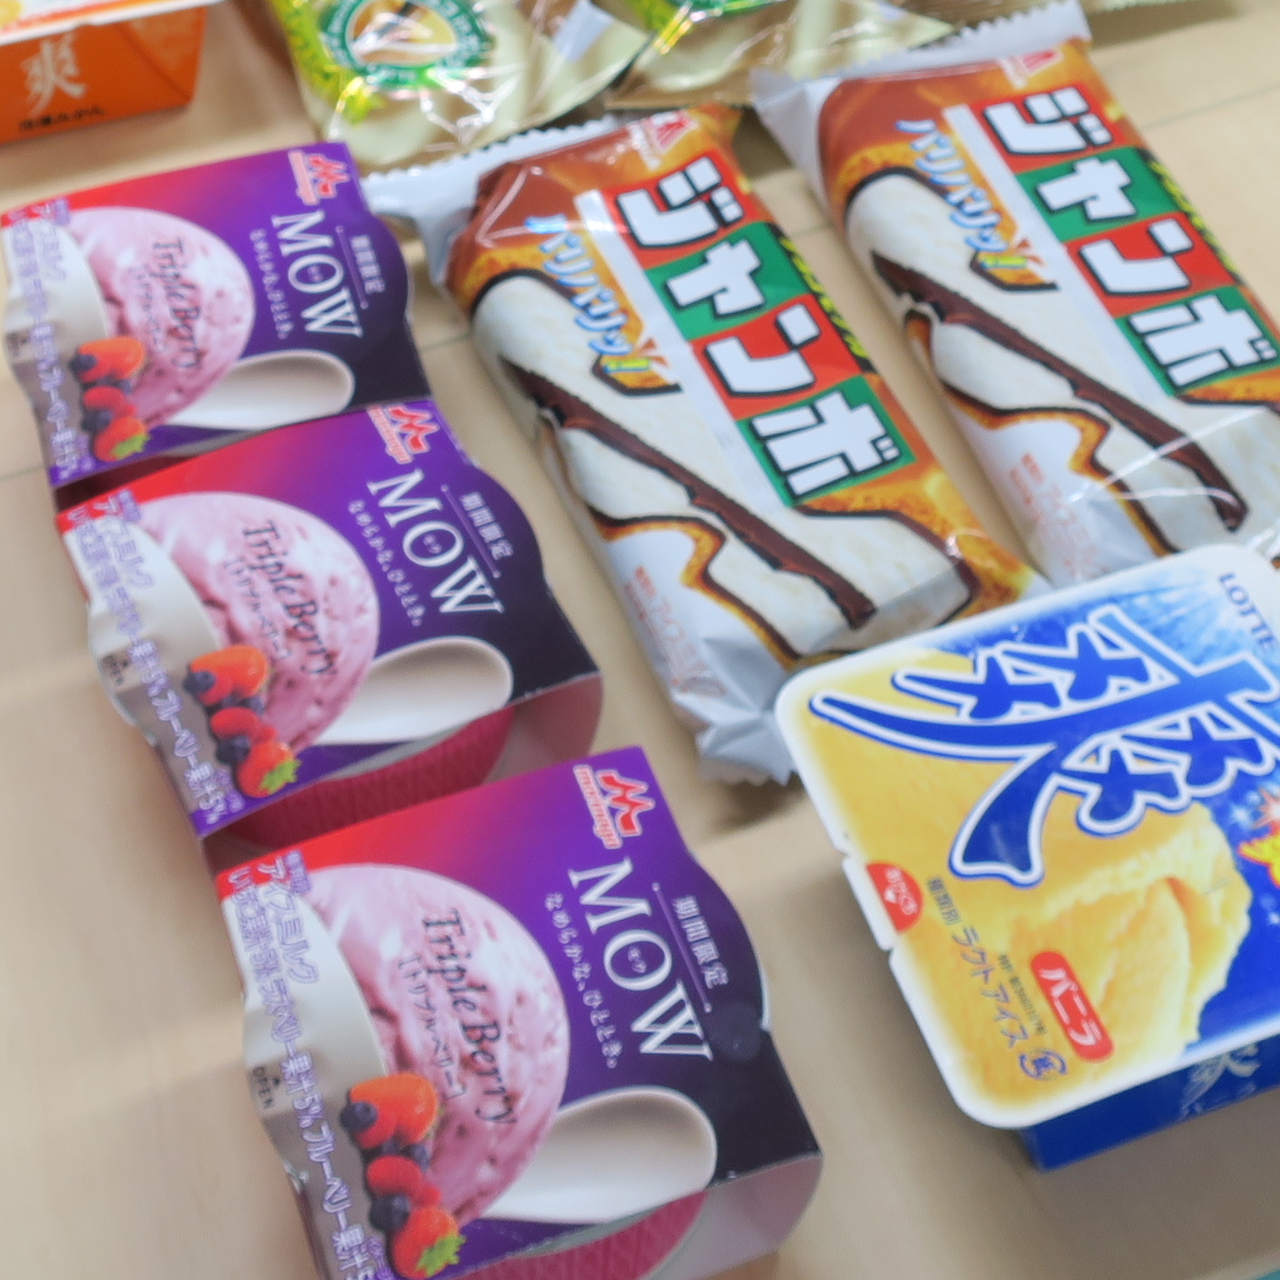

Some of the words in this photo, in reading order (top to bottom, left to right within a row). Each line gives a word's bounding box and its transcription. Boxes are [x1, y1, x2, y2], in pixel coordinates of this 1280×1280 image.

[271, 211, 363, 338] MOW
[982, 85, 1280, 395] ジャンボ
[615, 157, 904, 500] ジャンボ
[347, 499, 427, 628] なめらかな、ひととき。
[367, 469, 505, 616] MOW
[459, 490, 514, 562] 期間限定
[242, 519, 304, 601] Triple
[280, 595, 338, 680] Berry
[1219, 571, 1280, 656] LOTTE
[257, 856, 320, 986] アイスミルク
[544, 892, 621, 1070] なめらかな、ひととき。
[567, 857, 715, 1062] MOW
[671, 894, 730, 988] 期間限定
[422, 907, 483, 1015] Triple
[460, 1014, 519, 1128] Berry
[947, 924, 1034, 1051] ラクトアイス
[1037, 961, 1106, 1051] バニラ
[251, 1064, 276, 1111] OPEN
